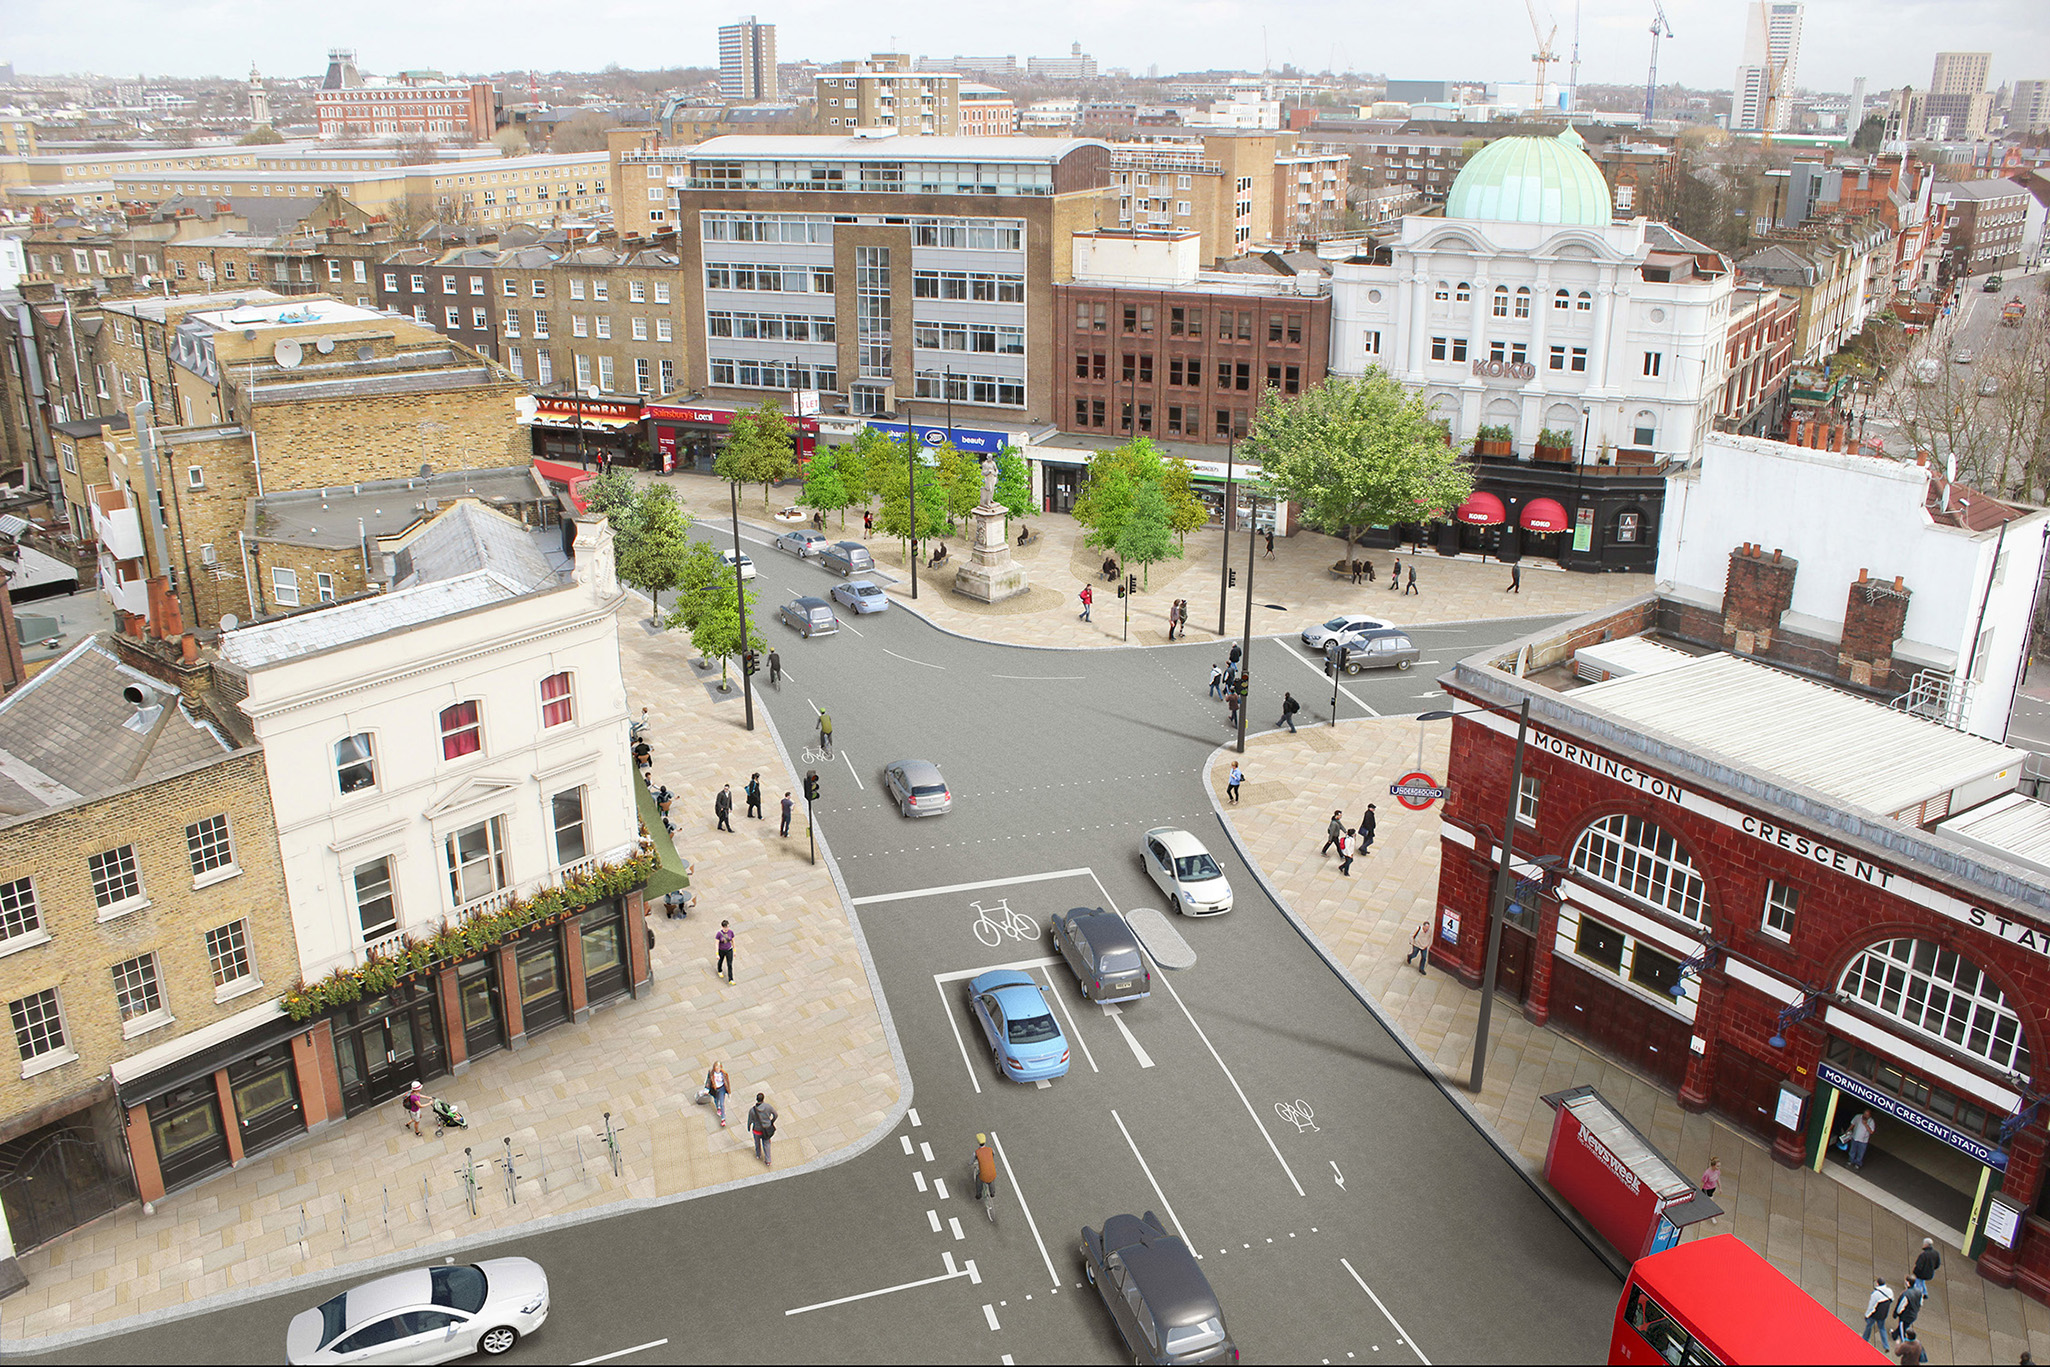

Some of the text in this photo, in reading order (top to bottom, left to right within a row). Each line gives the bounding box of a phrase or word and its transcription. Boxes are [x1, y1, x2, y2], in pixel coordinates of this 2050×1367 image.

[1472, 359, 1536, 380] KOKO
[805, 399, 818, 409] LET
[652, 408, 714, 421] Sainsbury's Local
[961, 435, 986, 446] beauty
[1468, 513, 1488, 521] KOKO
[1530, 520, 1551, 528] KOKO
[1534, 731, 2050, 954] MORNINGTON CRESCENT STAT
[1447, 918, 1454, 929] 4
[1825, 1070, 1894, 1111] MORNINGTON
[1895, 1106, 1950, 1139] CRESCENT
[1950, 1134, 1995, 1164] STATIO
[1577, 1123, 1642, 1194] Newsweek
